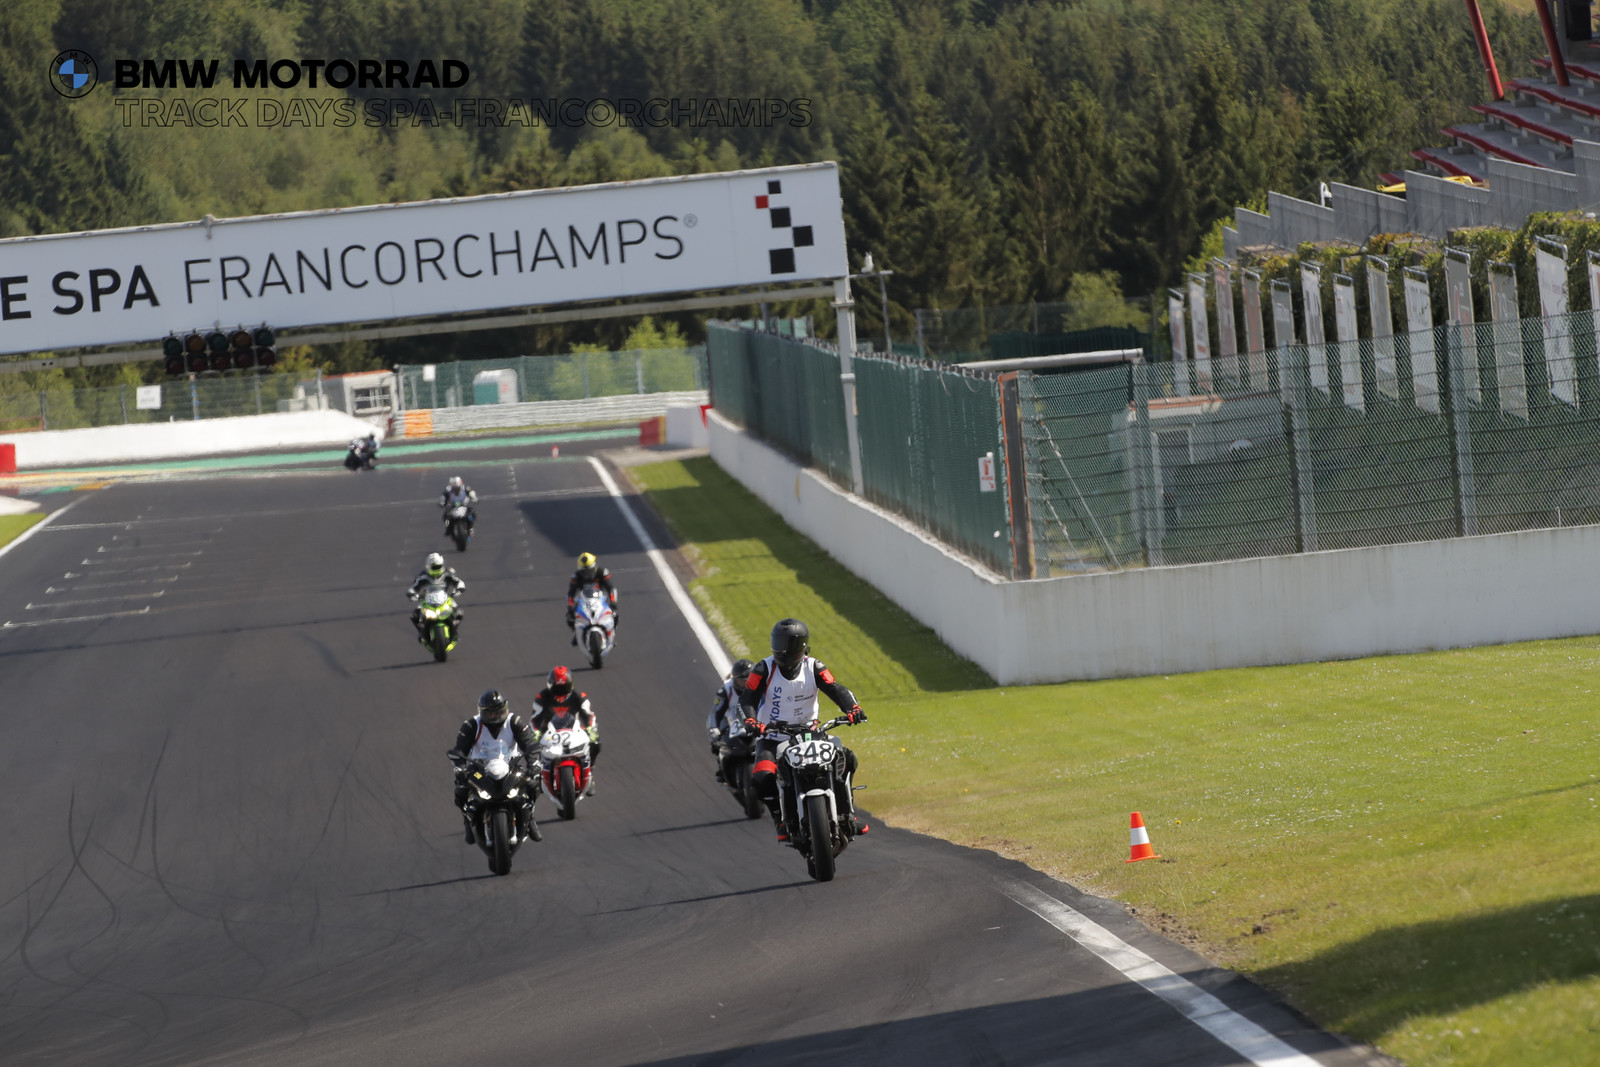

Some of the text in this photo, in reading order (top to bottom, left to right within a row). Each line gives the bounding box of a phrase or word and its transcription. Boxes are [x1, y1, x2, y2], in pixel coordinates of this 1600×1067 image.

[52, 265, 160, 315] SPA
[552, 732, 571, 747] 92
[790, 741, 832, 767] 348
